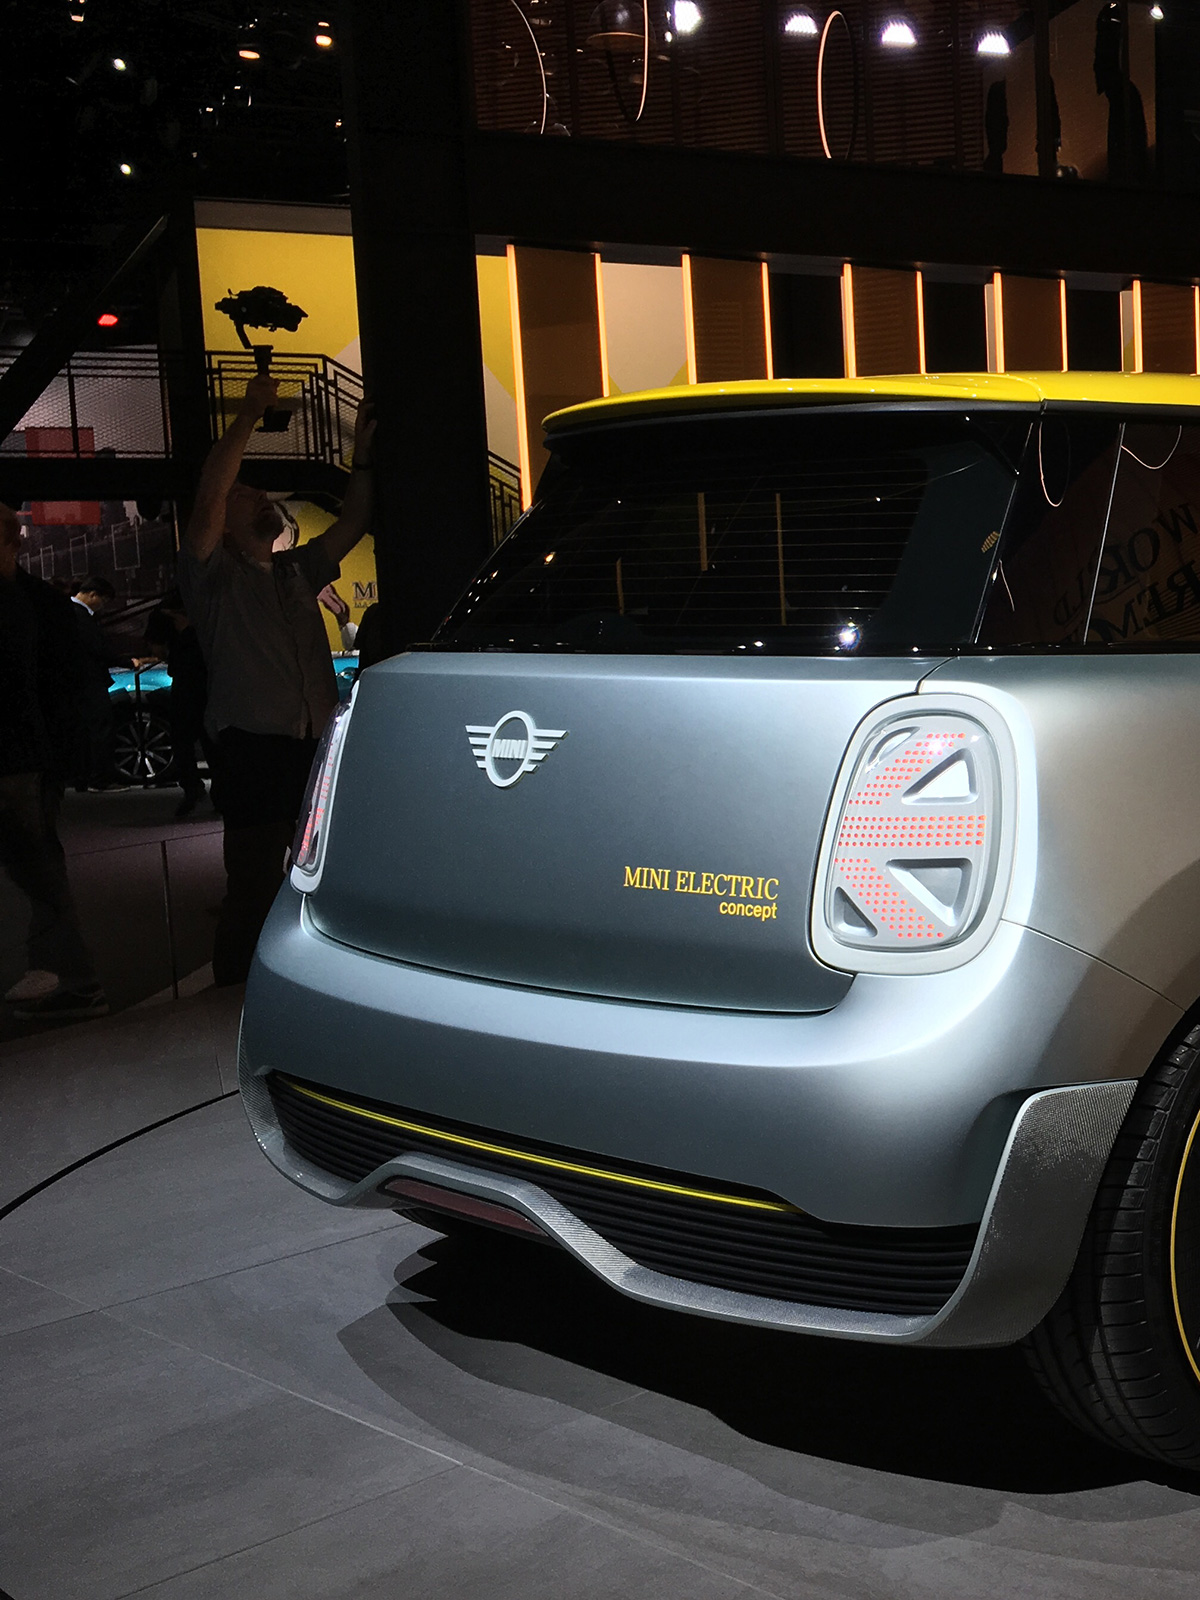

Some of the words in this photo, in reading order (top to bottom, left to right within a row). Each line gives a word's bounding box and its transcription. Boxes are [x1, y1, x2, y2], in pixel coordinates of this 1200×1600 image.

[491, 738, 528, 759] MINI
[623, 865, 671, 891] MINI
[674, 870, 779, 900] ELECTRIC
[719, 901, 778, 922] concept
